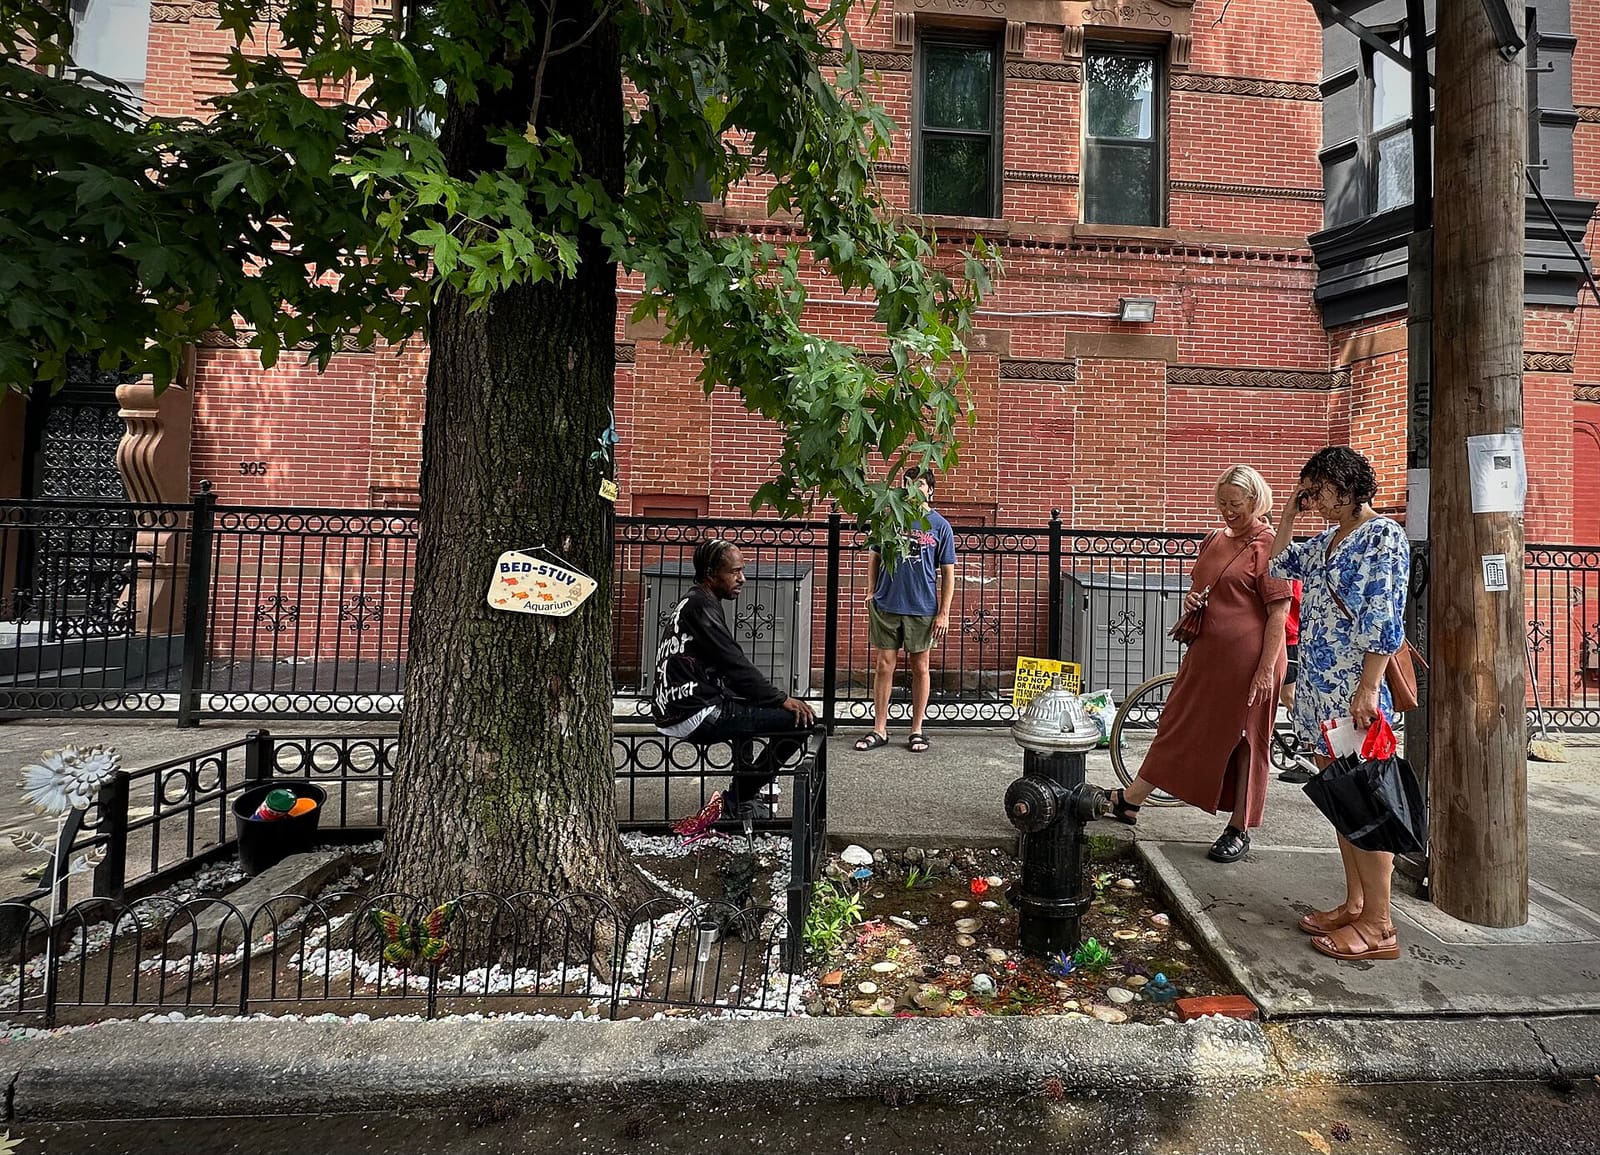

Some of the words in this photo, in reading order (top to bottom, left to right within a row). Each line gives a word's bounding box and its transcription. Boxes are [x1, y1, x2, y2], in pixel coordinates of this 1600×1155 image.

[239, 462, 267, 475] 305
[500, 562, 577, 586] BED-STUY
[523, 600, 573, 612] Aquarium
[1016, 681, 1027, 689] OR
[1028, 683, 1046, 691] TAKE
